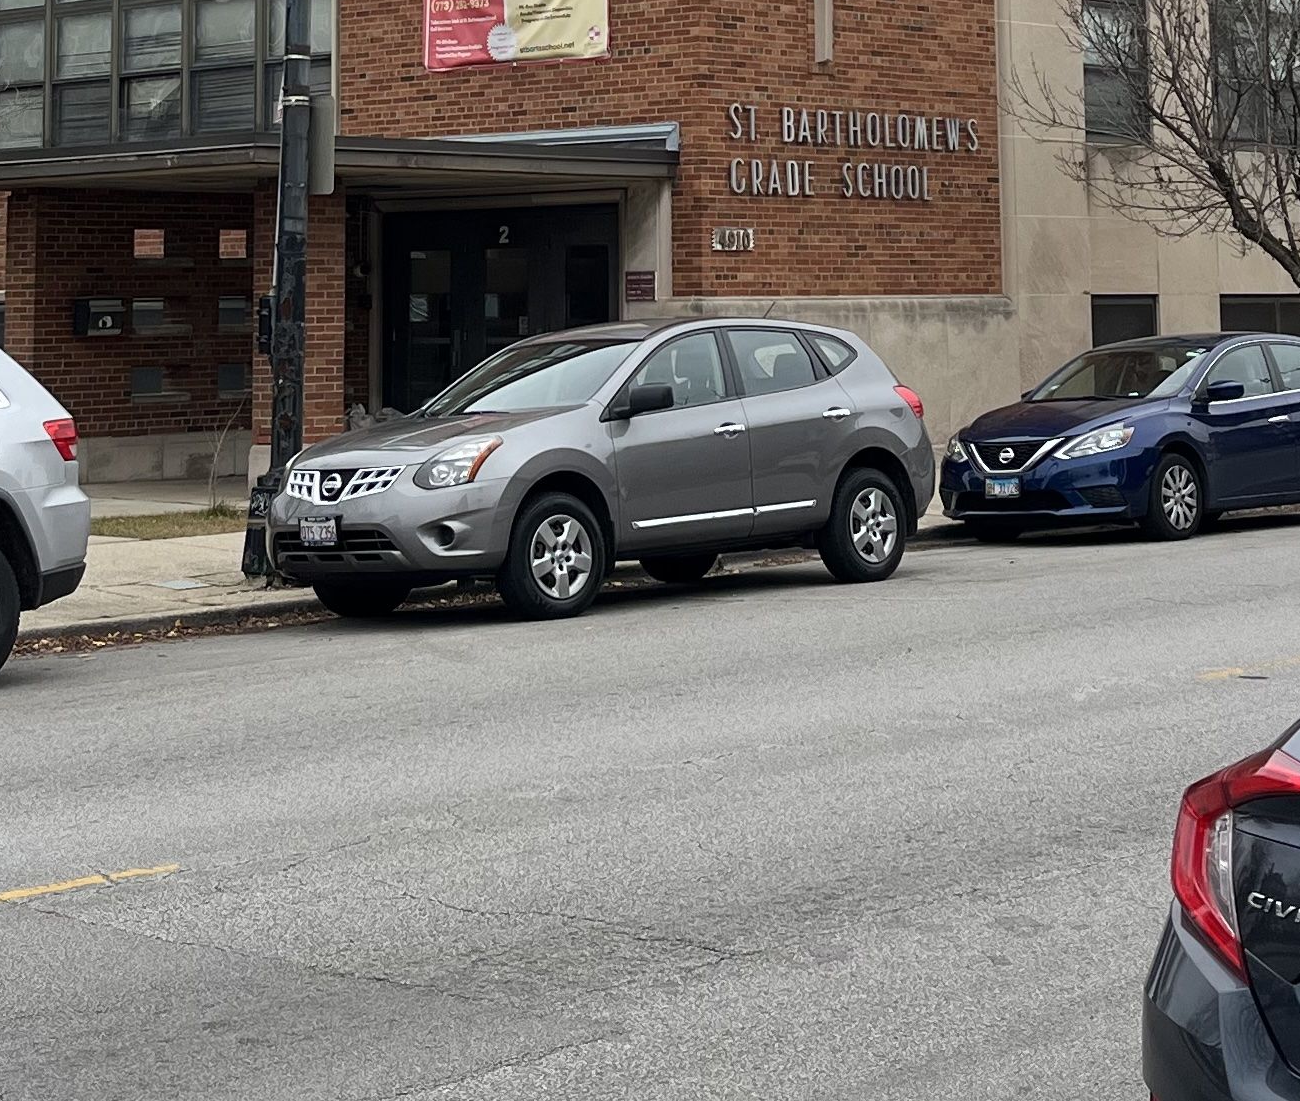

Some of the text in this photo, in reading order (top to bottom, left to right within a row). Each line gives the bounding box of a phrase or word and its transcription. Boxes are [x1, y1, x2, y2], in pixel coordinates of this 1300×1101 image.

[730, 158, 933, 200] GRADE SCHOOL
[499, 225, 509, 244] 2
